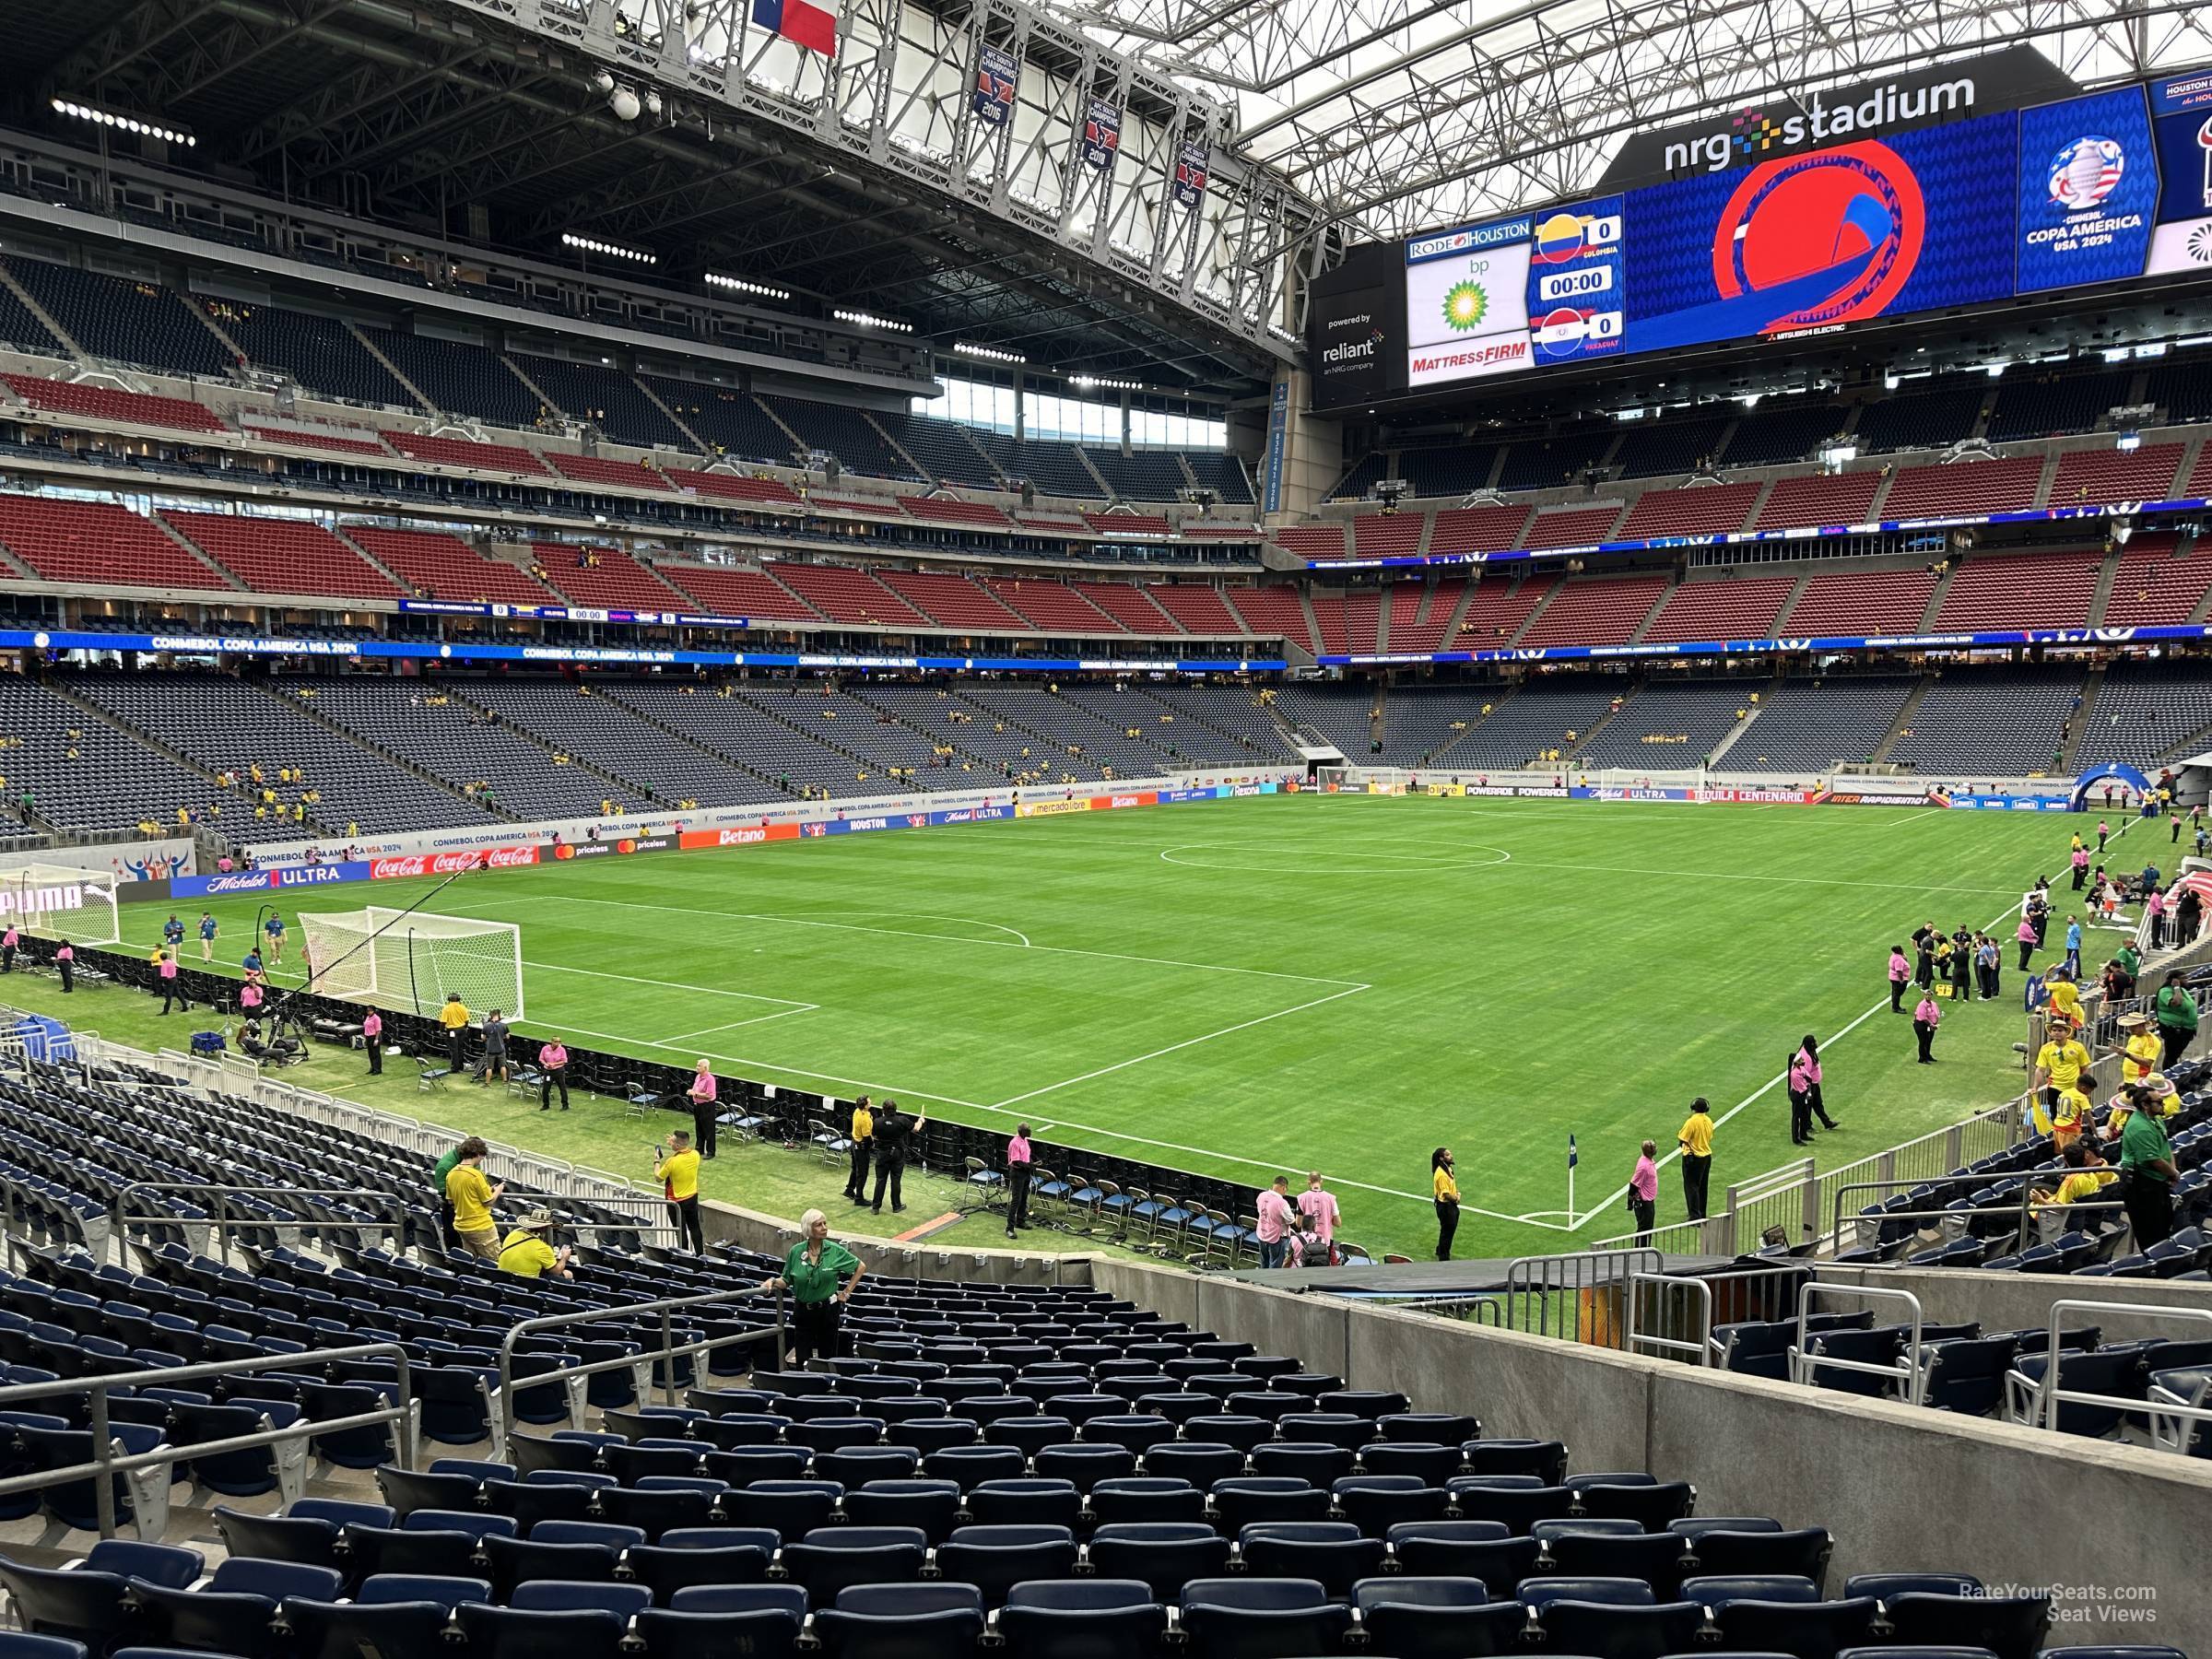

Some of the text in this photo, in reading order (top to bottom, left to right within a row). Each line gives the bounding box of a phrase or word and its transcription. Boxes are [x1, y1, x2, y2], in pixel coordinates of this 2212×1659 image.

[986, 51, 1012, 67] AFC SOUTH
[982, 56, 1014, 78] CHAMPIONS
[2167, 79, 2207, 95] HOUSTON
[982, 101, 1001, 120] 2016
[1090, 108, 1118, 126] CHAMPIONS
[1102, 107, 1116, 117] SOUTH
[1665, 78, 1974, 171] nrg stadium
[1088, 148, 1105, 165] 2018
[1182, 151, 1206, 168] CHAMPIONS
[1599, 223, 1609, 239] 0
[2027, 215, 2141, 244] COPA AMERICA
[2054, 234, 2112, 252] USA 2024
[1583, 246, 1618, 258] COLOMBIA
[1470, 260, 1489, 276] bp
[1550, 273, 1602, 295] 00:00
[1328, 314, 1371, 329] powered by
[1600, 319, 1610, 334] 0
[1777, 324, 1844, 340] MITSUBISHI ELECTRIC
[1324, 339, 1374, 361] reliant
[1332, 365, 1346, 373] NRG
[1347, 362, 1374, 371] company
[152, 638, 358, 653] CONMEBOL COPA AMERICA USA 2024
[523, 648, 674, 661] CONMEBOL COPA AMERICA USA 2024
[798, 655, 837, 665] CONMEBOL
[839, 656, 857, 665] COPA
[857, 657, 887, 665] AMERICA
[1234, 786, 1259, 796] Rexona
[1466, 787, 1513, 795] POWERADE
[1519, 788, 1568, 796] POWERADE
[1631, 789, 1666, 798] ULTRA
[1694, 790, 1805, 802] TEQUILA CENTENARIO
[1036, 800, 1086, 813] mercado libre
[1112, 796, 1137, 806] Betano
[716, 813, 747, 821] CONMEBOL
[945, 808, 1002, 823] Michelob ULTRA
[850, 818, 887, 830] HOUSTON
[433, 837, 474, 846] CONMEBOL
[476, 835, 494, 844] COPA
[496, 833, 526, 841] AMERICA
[719, 830, 765, 844] Betano
[576, 844, 608, 856] priceless
[637, 840, 667, 851] priceless
[255, 852, 303, 864] CONMEBOL
[433, 850, 483, 873] Coca-Cola
[488, 846, 534, 867] Coca-Cola
[374, 855, 428, 878] Coca-Cola
[206, 867, 340, 892] Michelob ULTRA
[0, 886, 83, 915] PUMA
